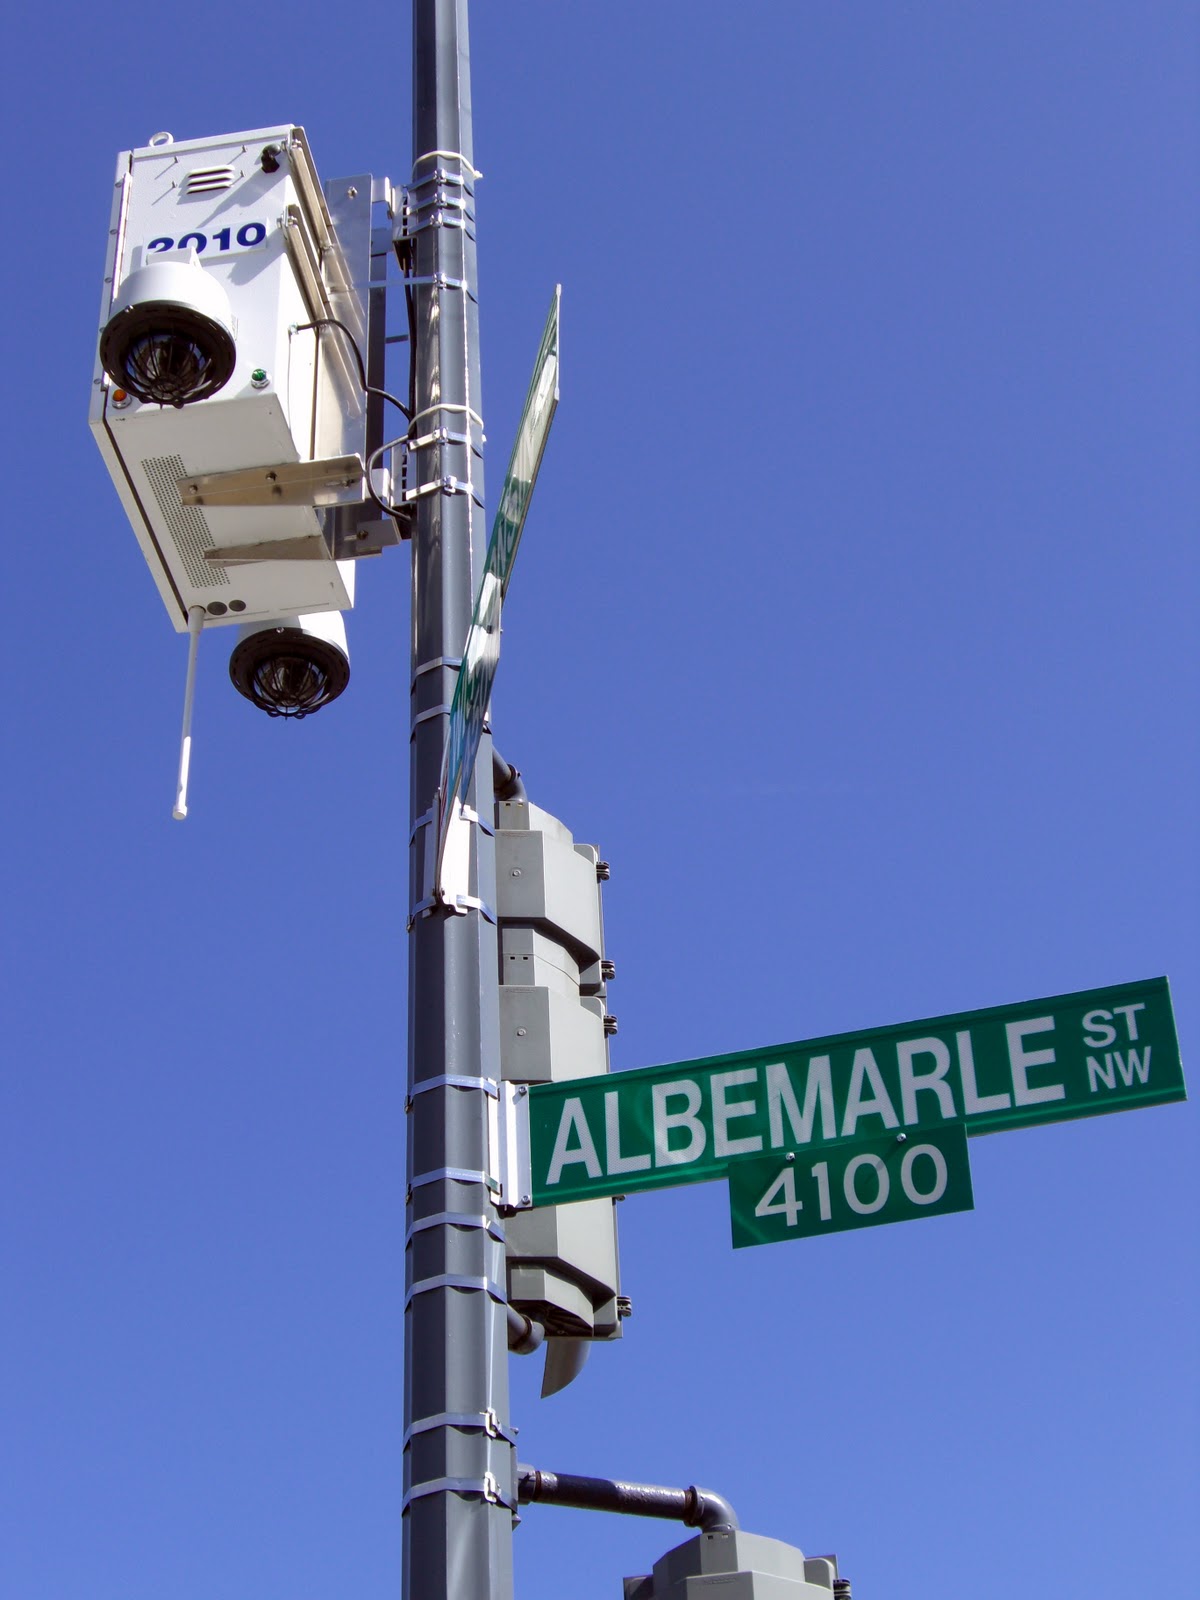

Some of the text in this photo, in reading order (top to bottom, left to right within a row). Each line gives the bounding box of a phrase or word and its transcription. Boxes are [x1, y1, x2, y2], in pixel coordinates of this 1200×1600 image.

[546, 1002, 1146, 1185] ALBEMARLE ST
[1086, 1046, 1152, 1092] NW
[755, 1144, 948, 1227] 4100
